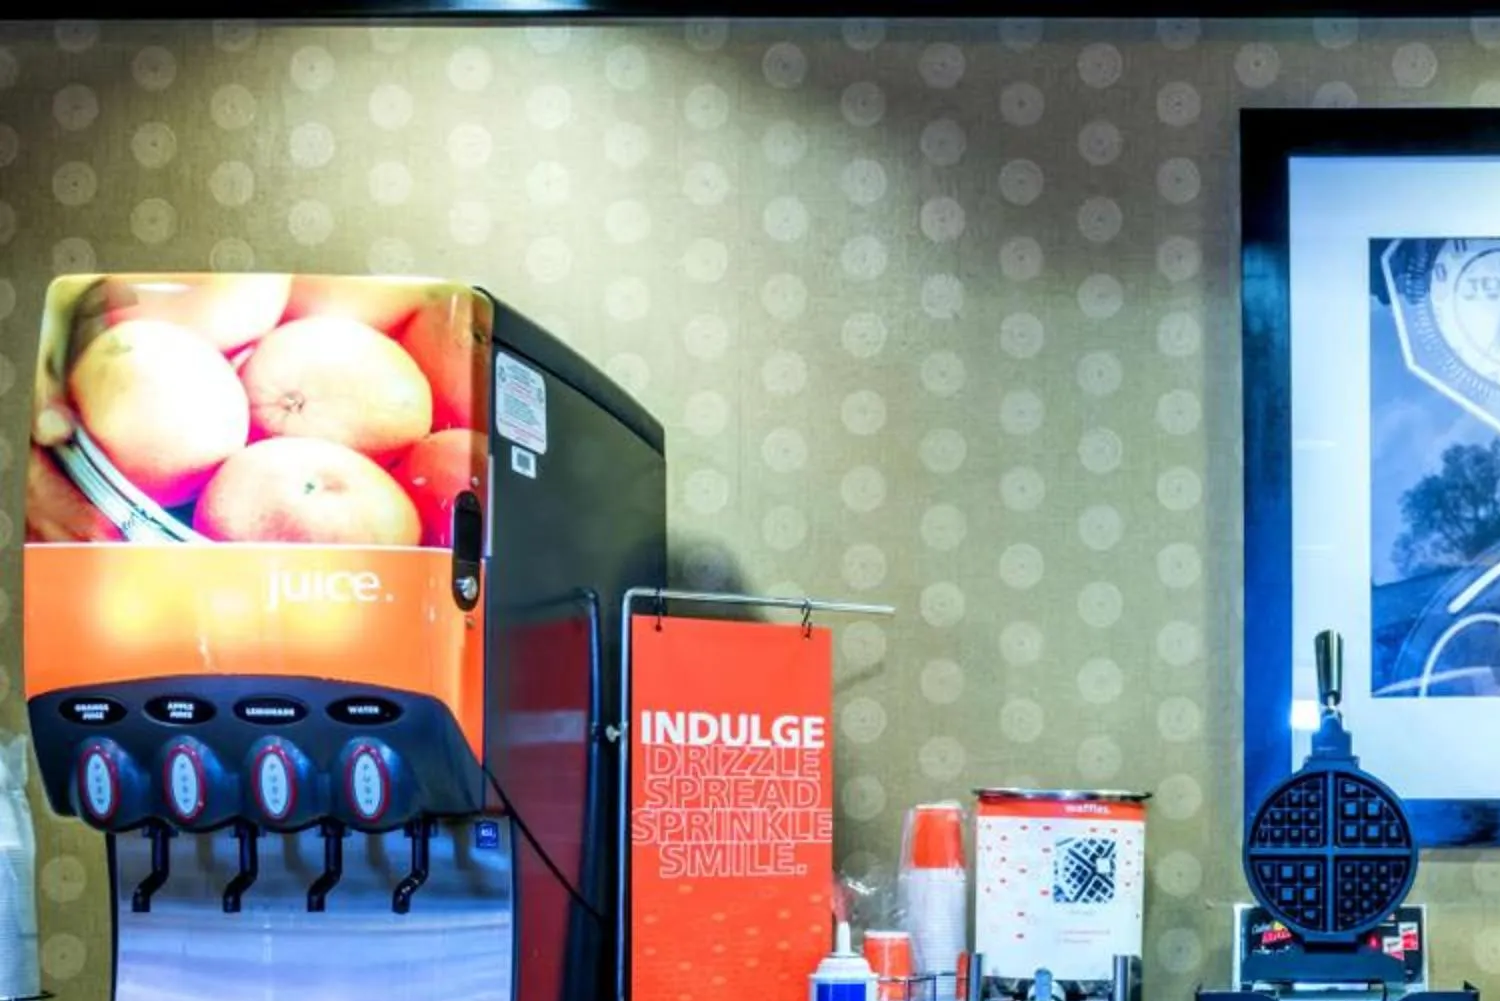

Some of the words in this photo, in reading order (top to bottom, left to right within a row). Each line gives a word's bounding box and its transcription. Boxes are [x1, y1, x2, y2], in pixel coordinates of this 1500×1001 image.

[347, 704, 380, 714] WATER
[640, 709, 825, 748] INDULGE
[644, 744, 821, 780] DRIZZLE
[644, 775, 821, 810] SPREAD
[631, 808, 833, 845] SPRINKLE
[659, 840, 808, 878] SMILE.
